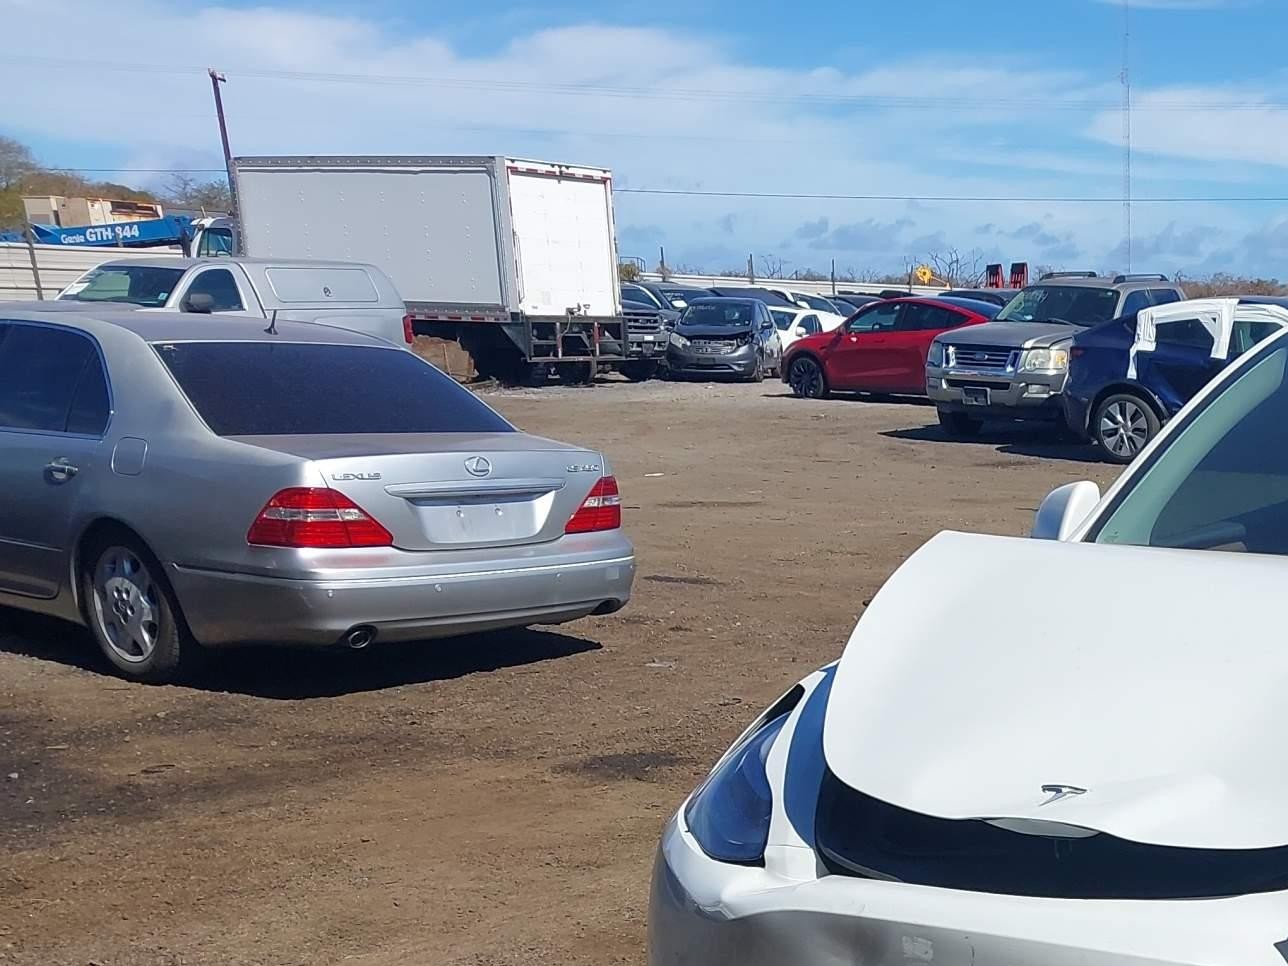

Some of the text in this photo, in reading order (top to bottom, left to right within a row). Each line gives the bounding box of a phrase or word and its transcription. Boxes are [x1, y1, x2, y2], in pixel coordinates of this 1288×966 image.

[61, 224, 140, 244] Genie GTH-844
[331, 472, 382, 481] LEXUS
